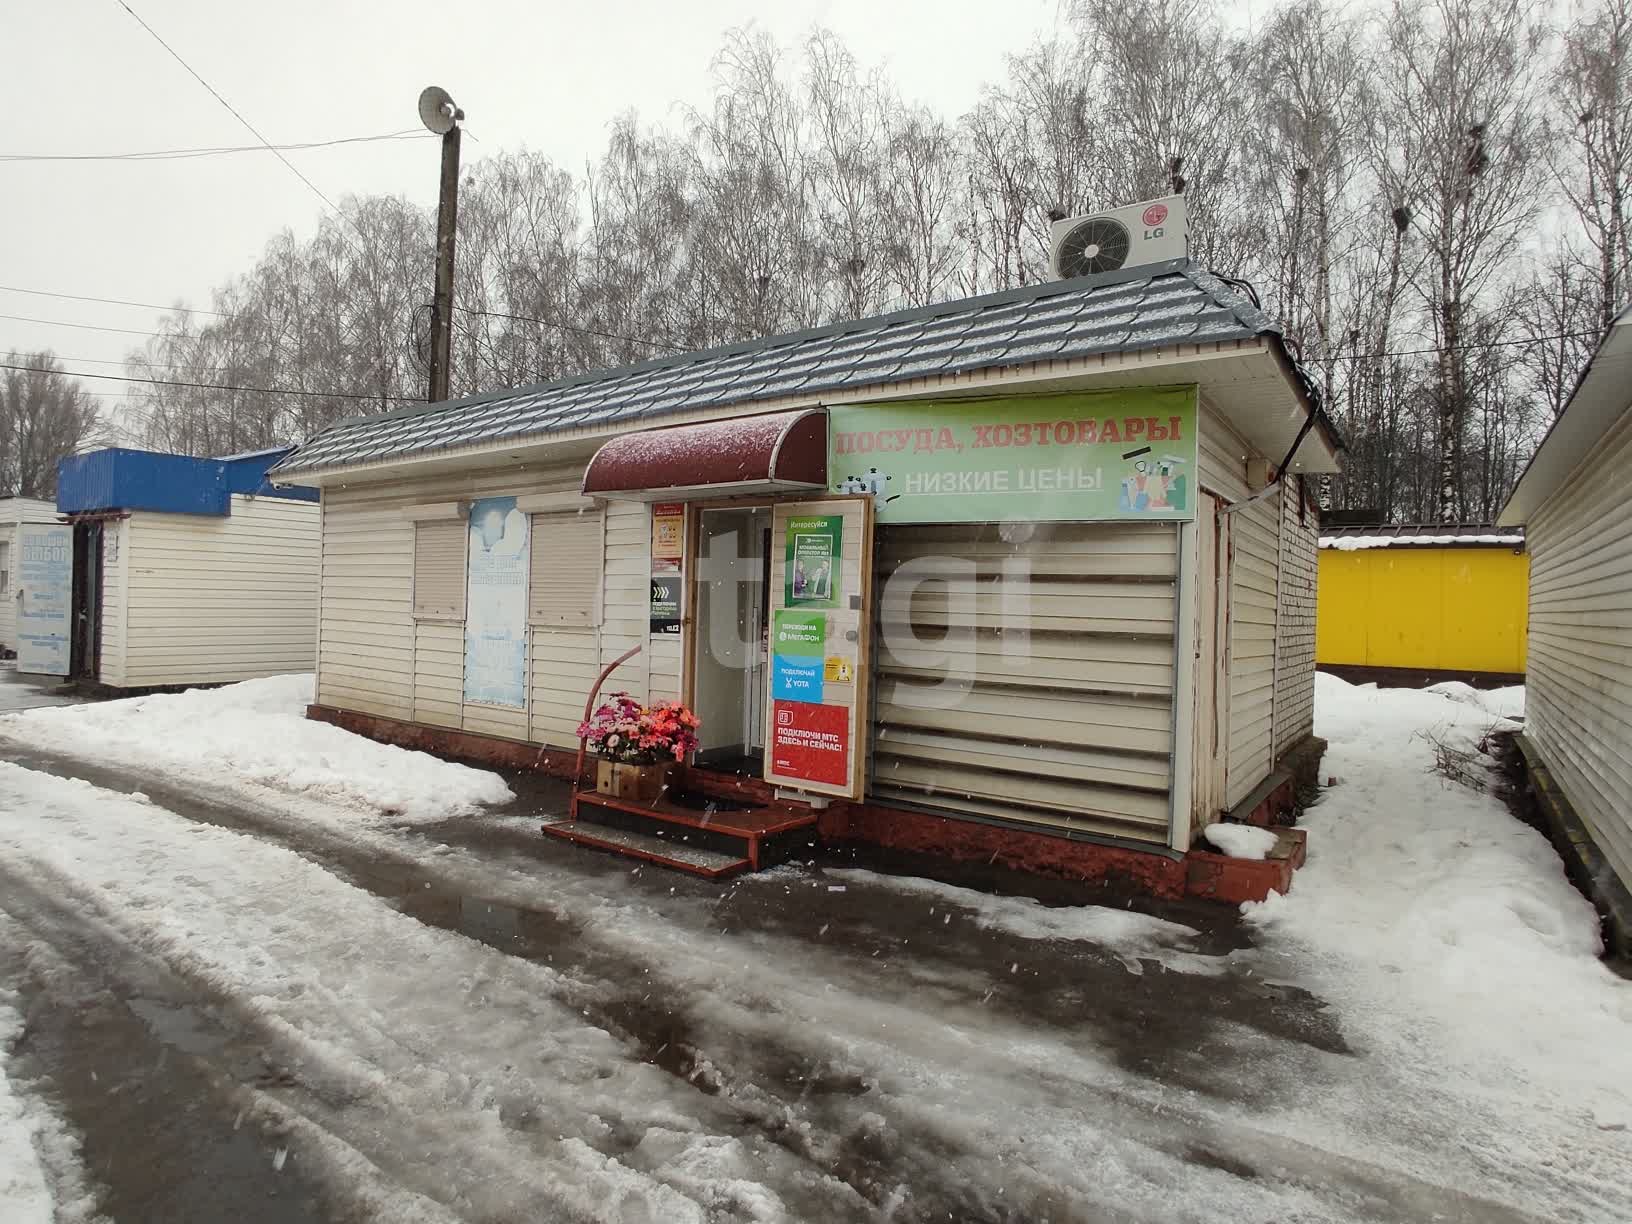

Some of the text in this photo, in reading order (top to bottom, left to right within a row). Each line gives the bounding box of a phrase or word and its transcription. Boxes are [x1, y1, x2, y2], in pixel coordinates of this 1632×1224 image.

[1144, 227, 1164, 240] LG
[835, 416, 1182, 455] ПОСУДА, ХОЗТОВАРЫ
[904, 466, 1102, 494] НИЗКИЕ ЦЕНЫ
[790, 520, 828, 529] Интересуйся
[793, 680, 810, 688] YOTA
[777, 727, 839, 742] ПОДКЛЮЧИ МТС
[777, 736, 802, 746] ЗДЕСЬ
[809, 740, 843, 752] СЕЙЧАС!
